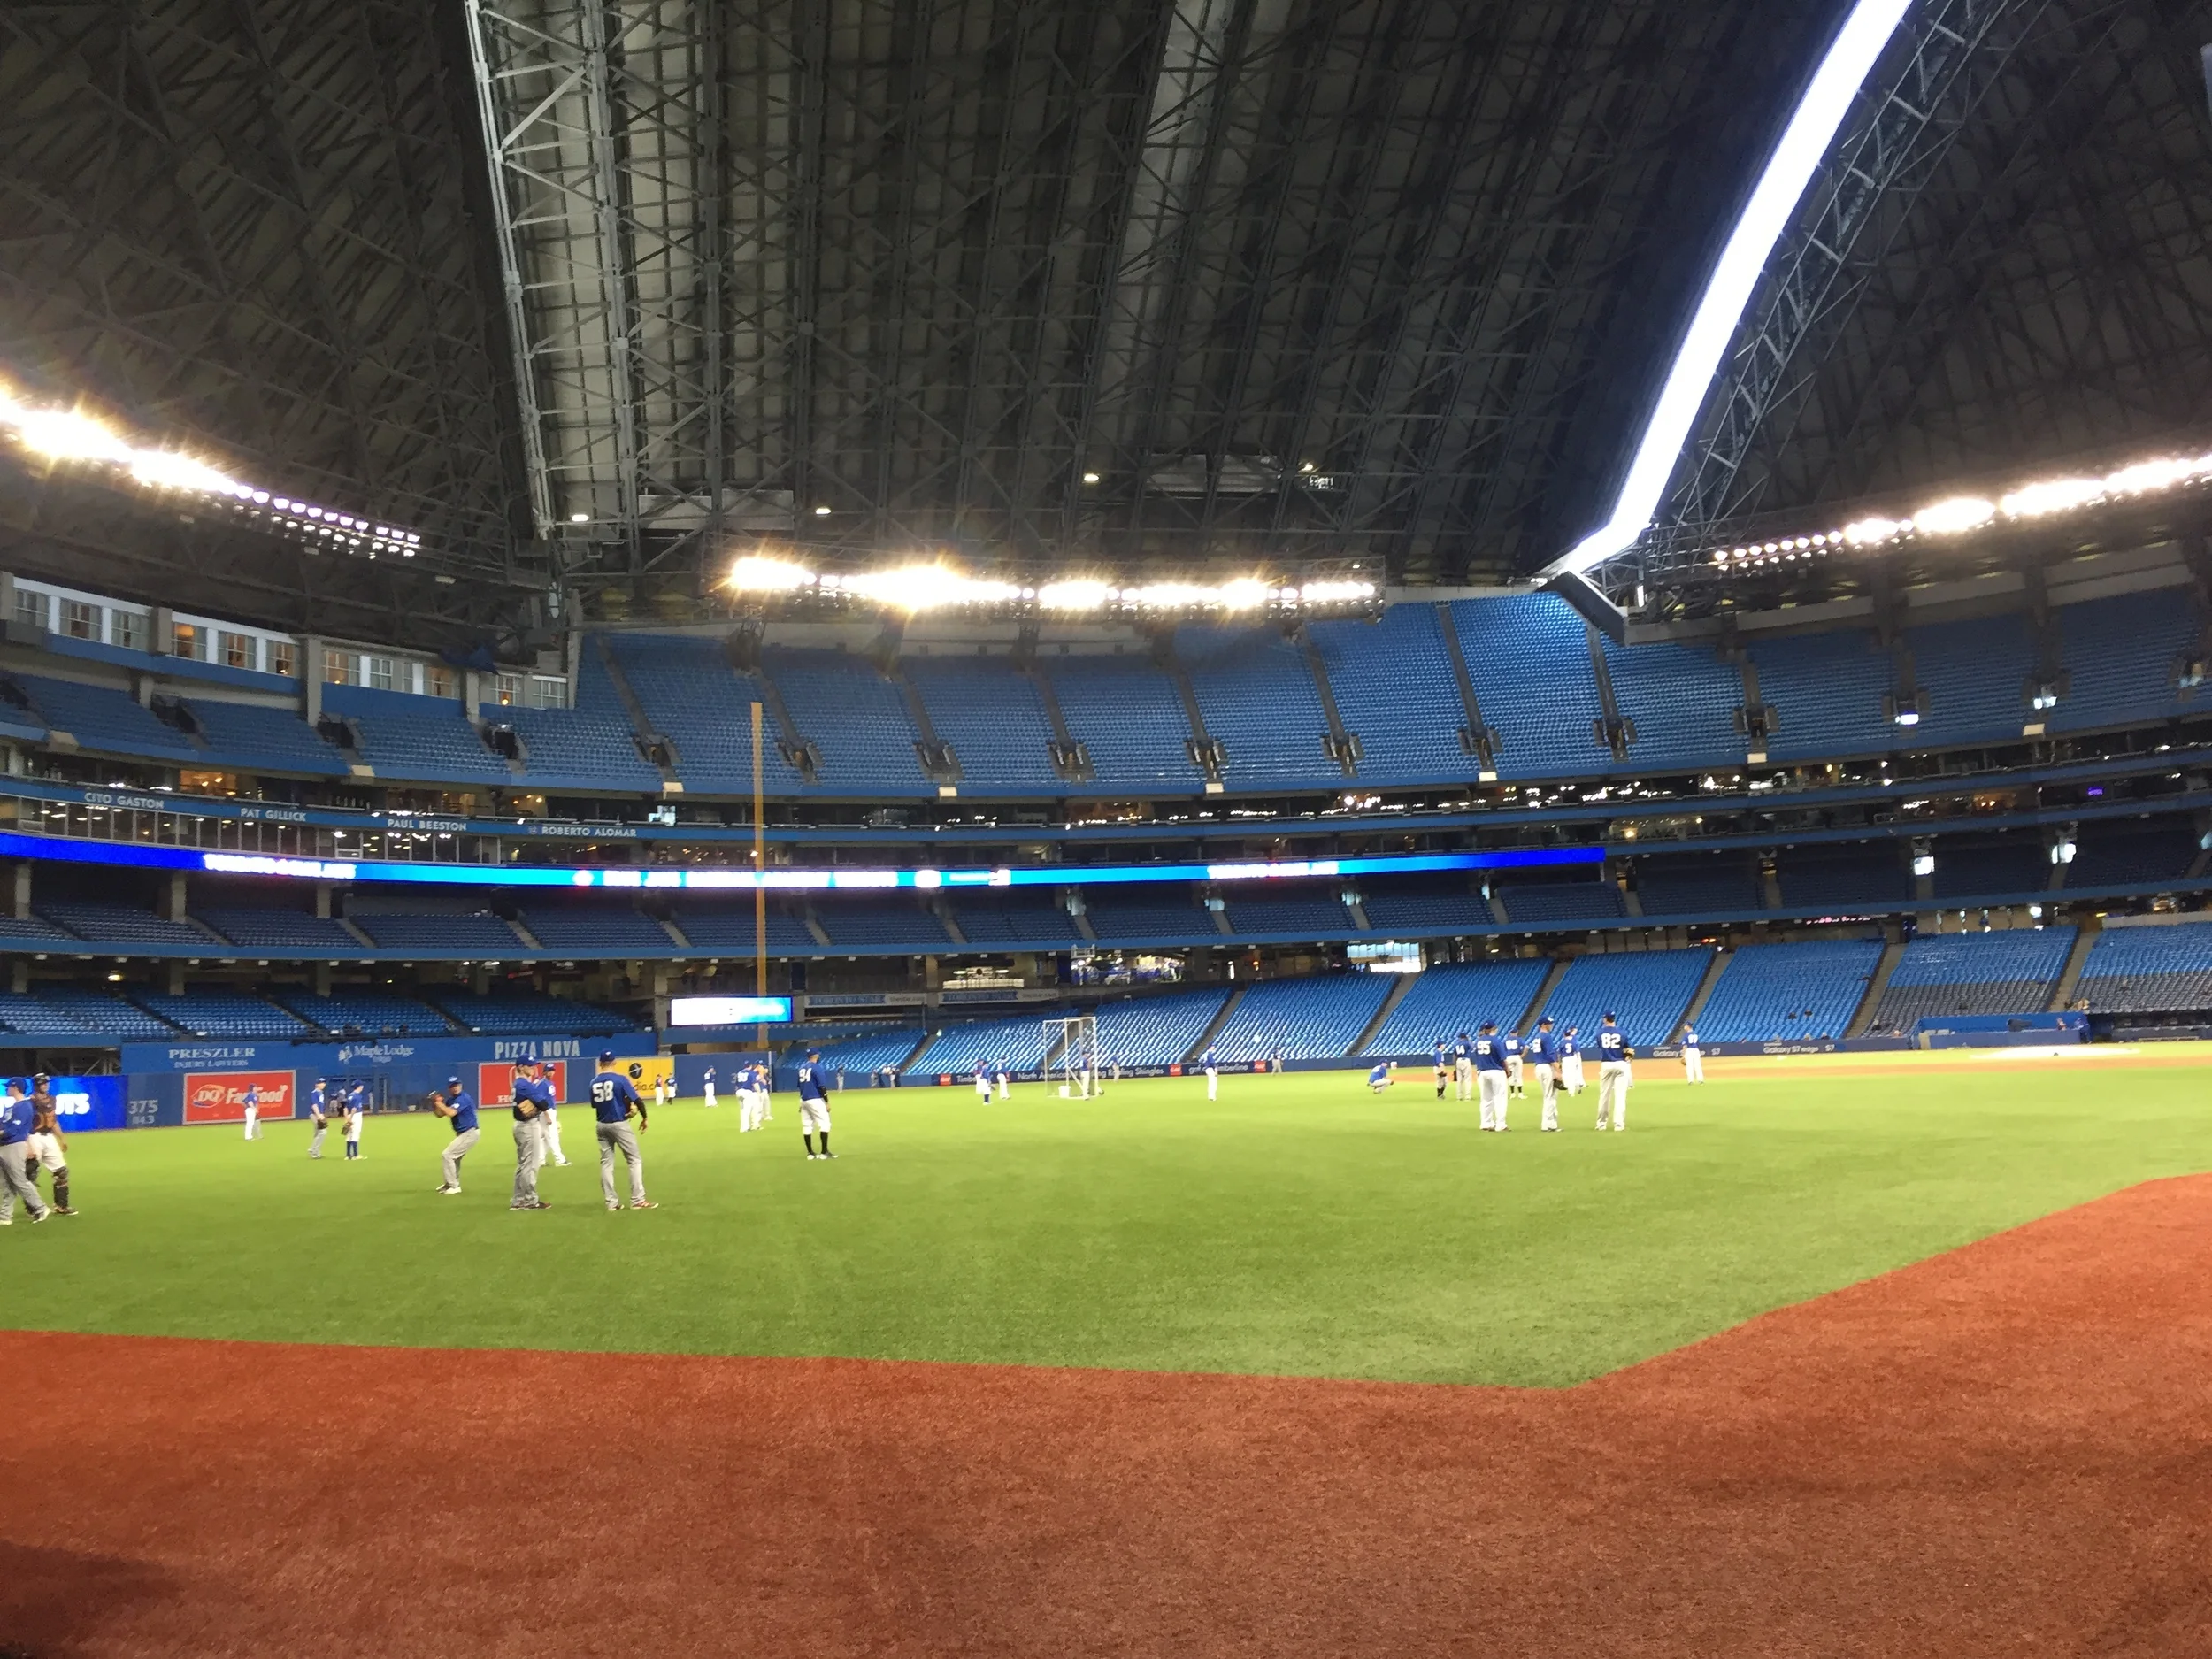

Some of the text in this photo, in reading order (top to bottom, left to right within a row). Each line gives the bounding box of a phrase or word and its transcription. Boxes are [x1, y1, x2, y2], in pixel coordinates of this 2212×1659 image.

[84, 792, 165, 810] CITO GASTON
[240, 807, 307, 822] PAT GILLICK
[387, 818, 467, 831] PAUL BEESTON
[541, 826, 637, 838] ROBERTO ALOMAR
[1477, 1040, 1492, 1055] 95
[1564, 1043, 1572, 1053] 5
[1601, 1033, 1621, 1048] 82
[168, 1048, 256, 1059] PRESZLER
[354, 1044, 414, 1058] Maple Lodge
[495, 1040, 580, 1059] PIZZA NOVA
[798, 1067, 813, 1083] 94
[197, 1089, 221, 1102] DQ
[592, 1080, 614, 1102] 58
[128, 1100, 158, 1115] 375
